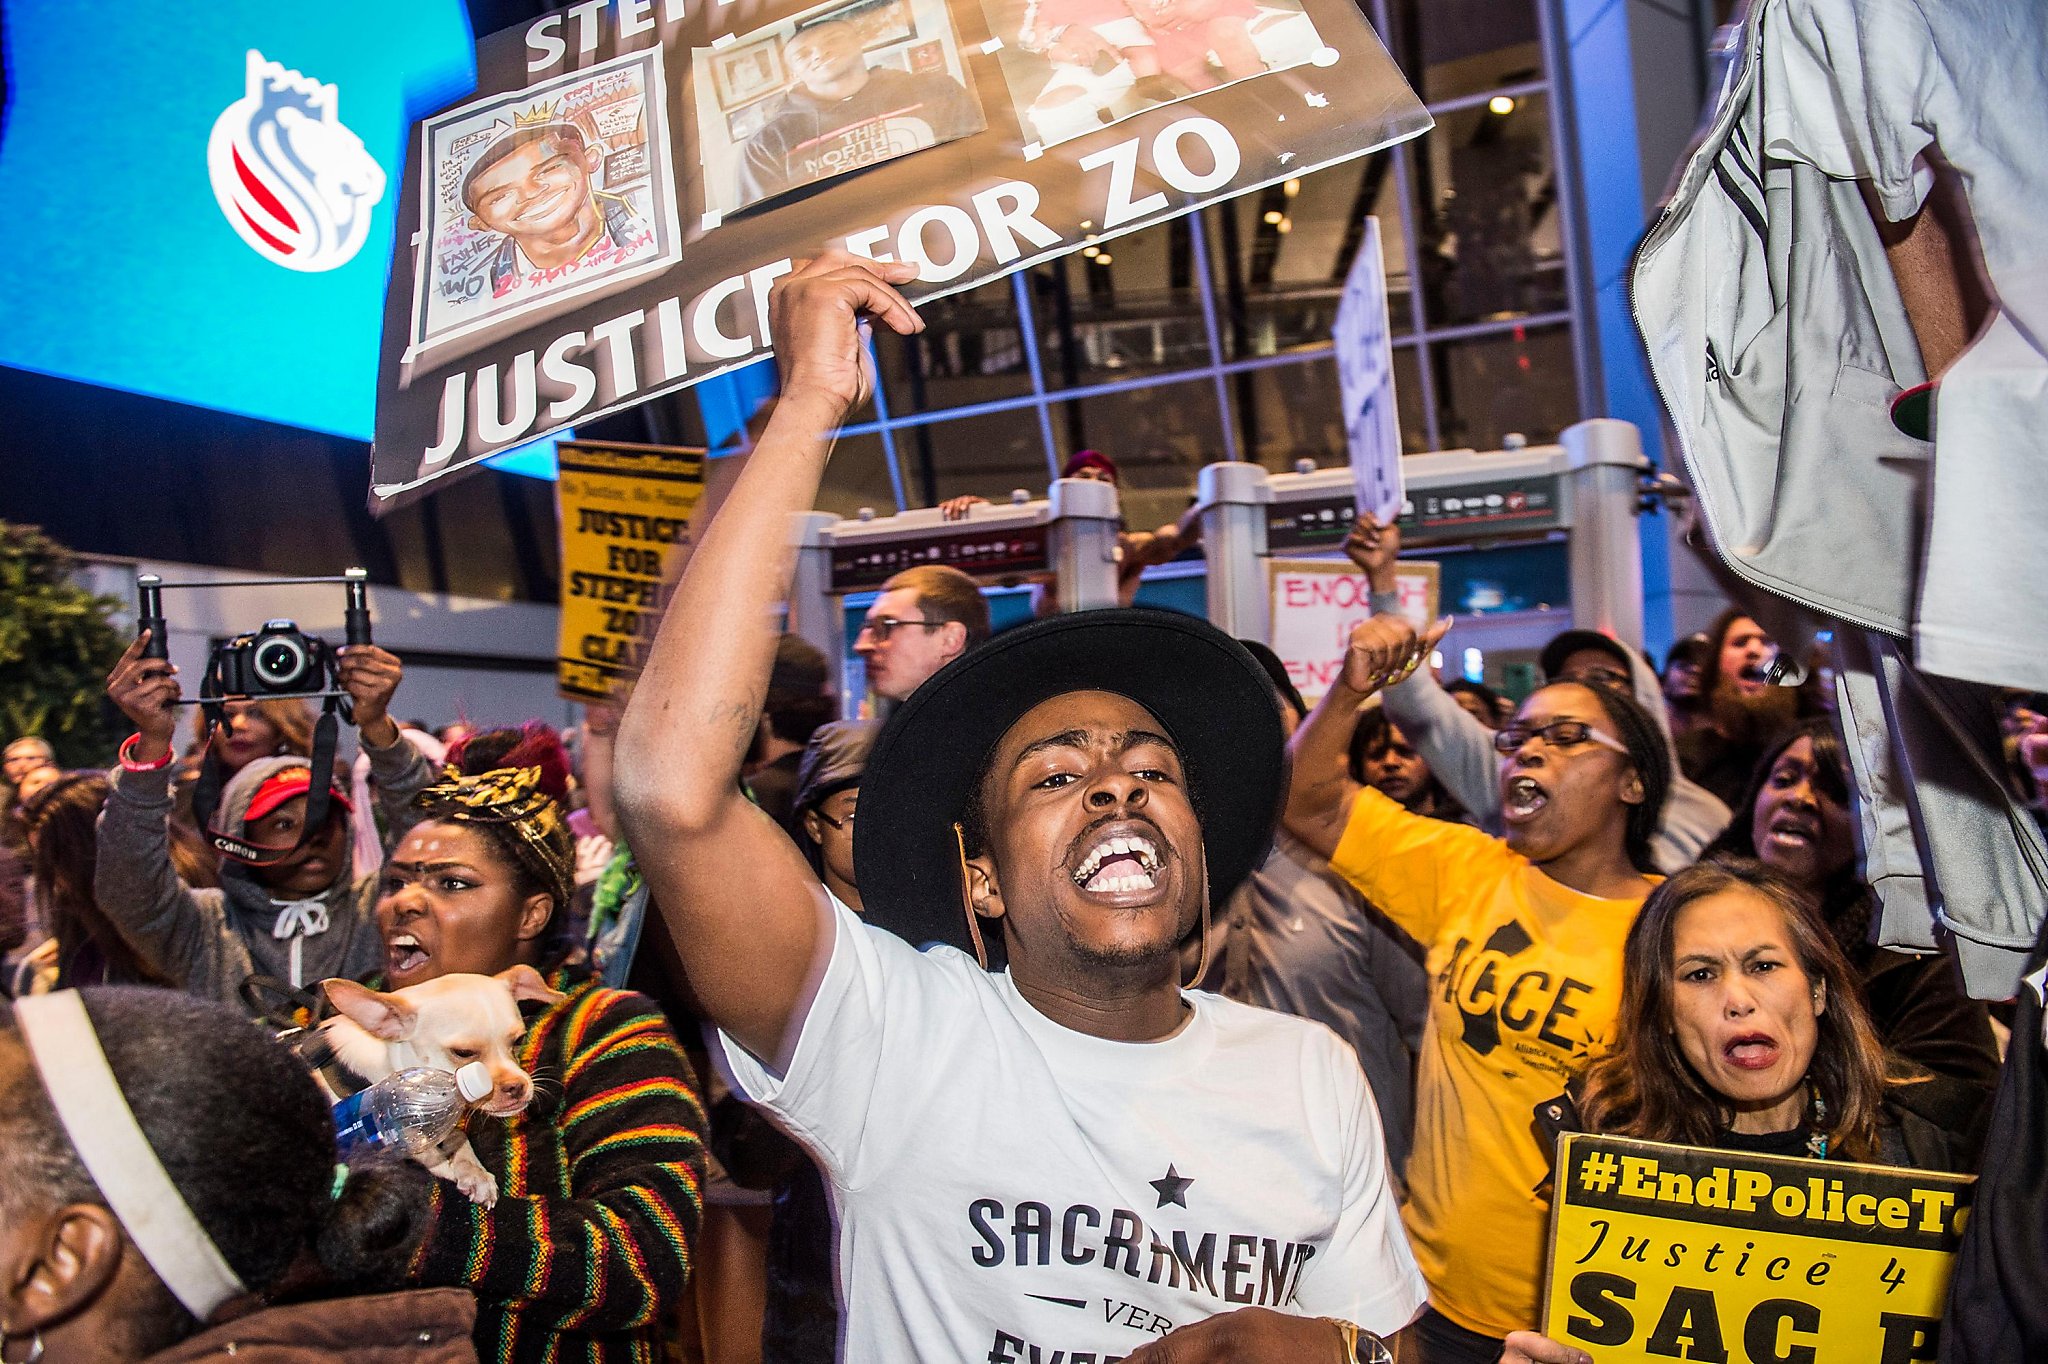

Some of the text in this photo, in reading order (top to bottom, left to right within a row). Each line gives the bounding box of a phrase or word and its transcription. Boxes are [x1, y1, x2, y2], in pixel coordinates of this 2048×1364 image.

[839, 119, 885, 145] THE
[805, 133, 889, 173] NORTH
[832, 148, 890, 174] FACE
[1078, 116, 1241, 230] ZO
[438, 234, 503, 275] FATHER
[577, 507, 690, 545] JUSTICE
[607, 544, 664, 577] FOR
[214, 838, 258, 860] Canon
[1574, 1219, 1907, 1296] Justice 4
[1566, 1271, 1822, 1364] SAC
